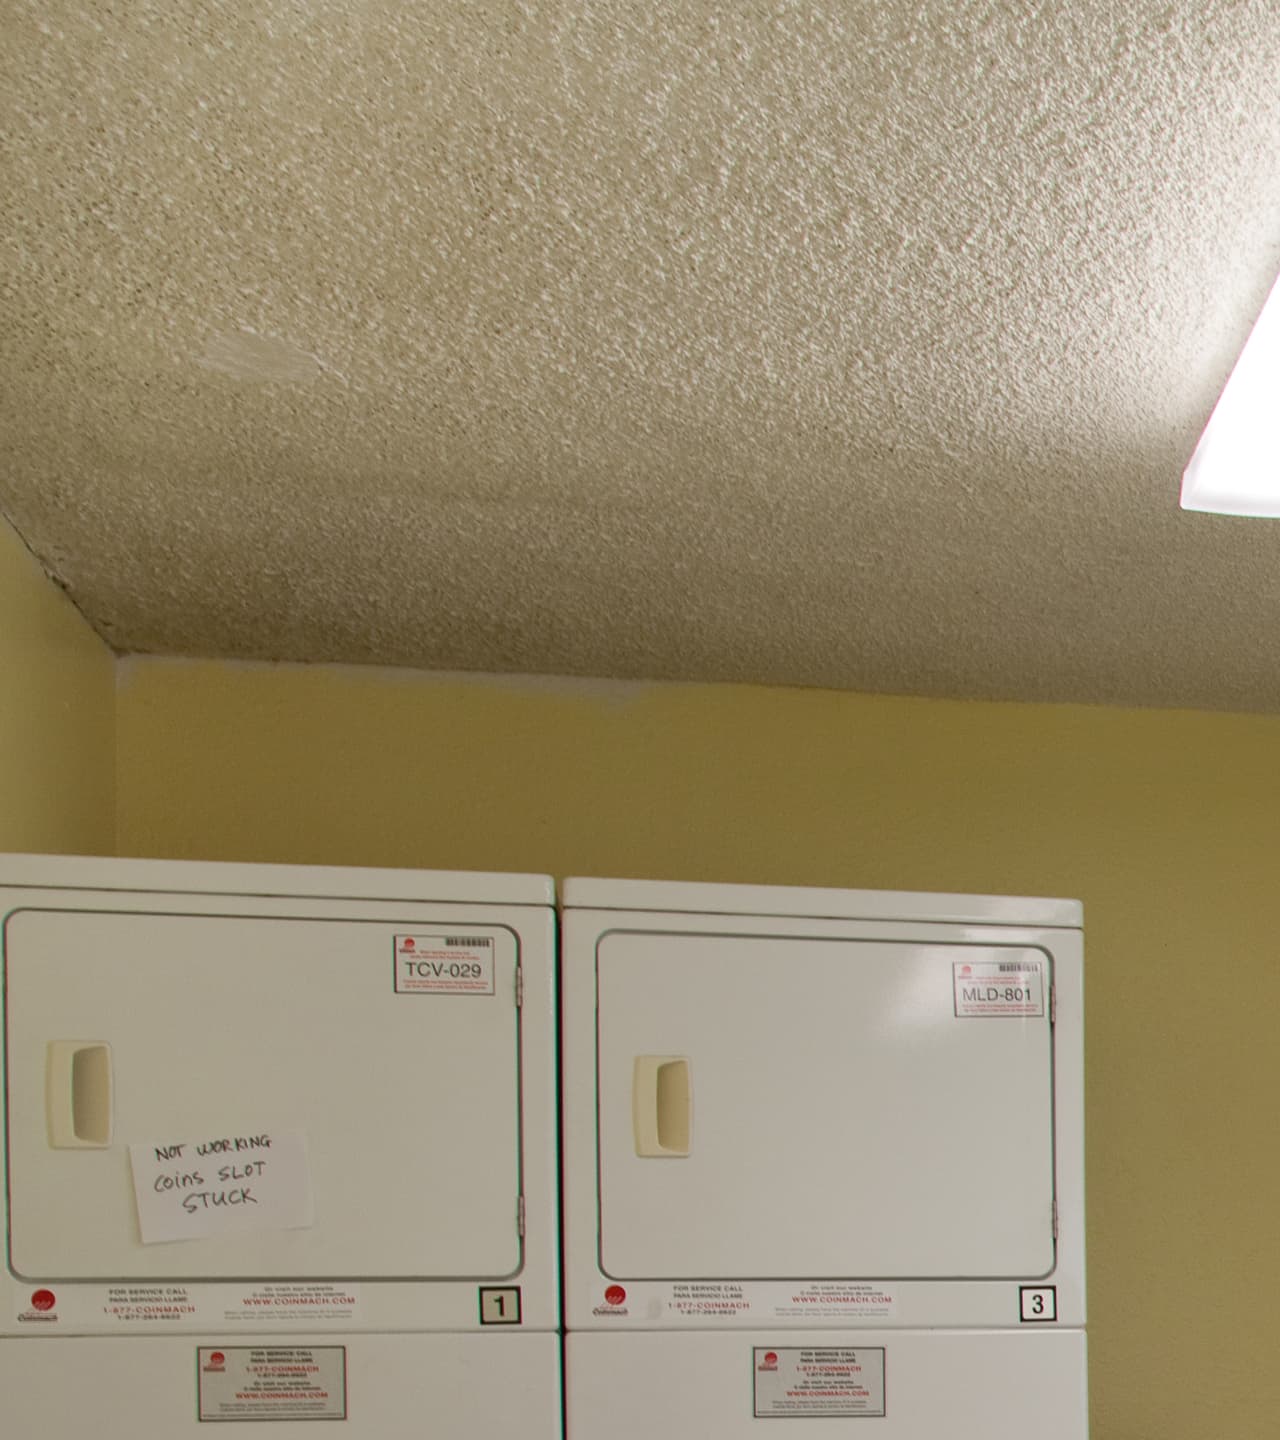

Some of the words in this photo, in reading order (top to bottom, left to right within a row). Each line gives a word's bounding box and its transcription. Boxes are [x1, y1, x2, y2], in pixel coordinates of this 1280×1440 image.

[405, 961, 482, 978] TCV-029
[962, 987, 1032, 1002] MLD-801
[155, 1144, 187, 1162] NOT
[196, 1134, 273, 1157] WORKING
[218, 1161, 267, 1182] SLOT
[182, 1188, 259, 1214] STUCK
[493, 1295, 505, 1317] 1
[668, 1302, 750, 1310] 1-877-COINMACH
[1032, 1294, 1044, 1315] 3
